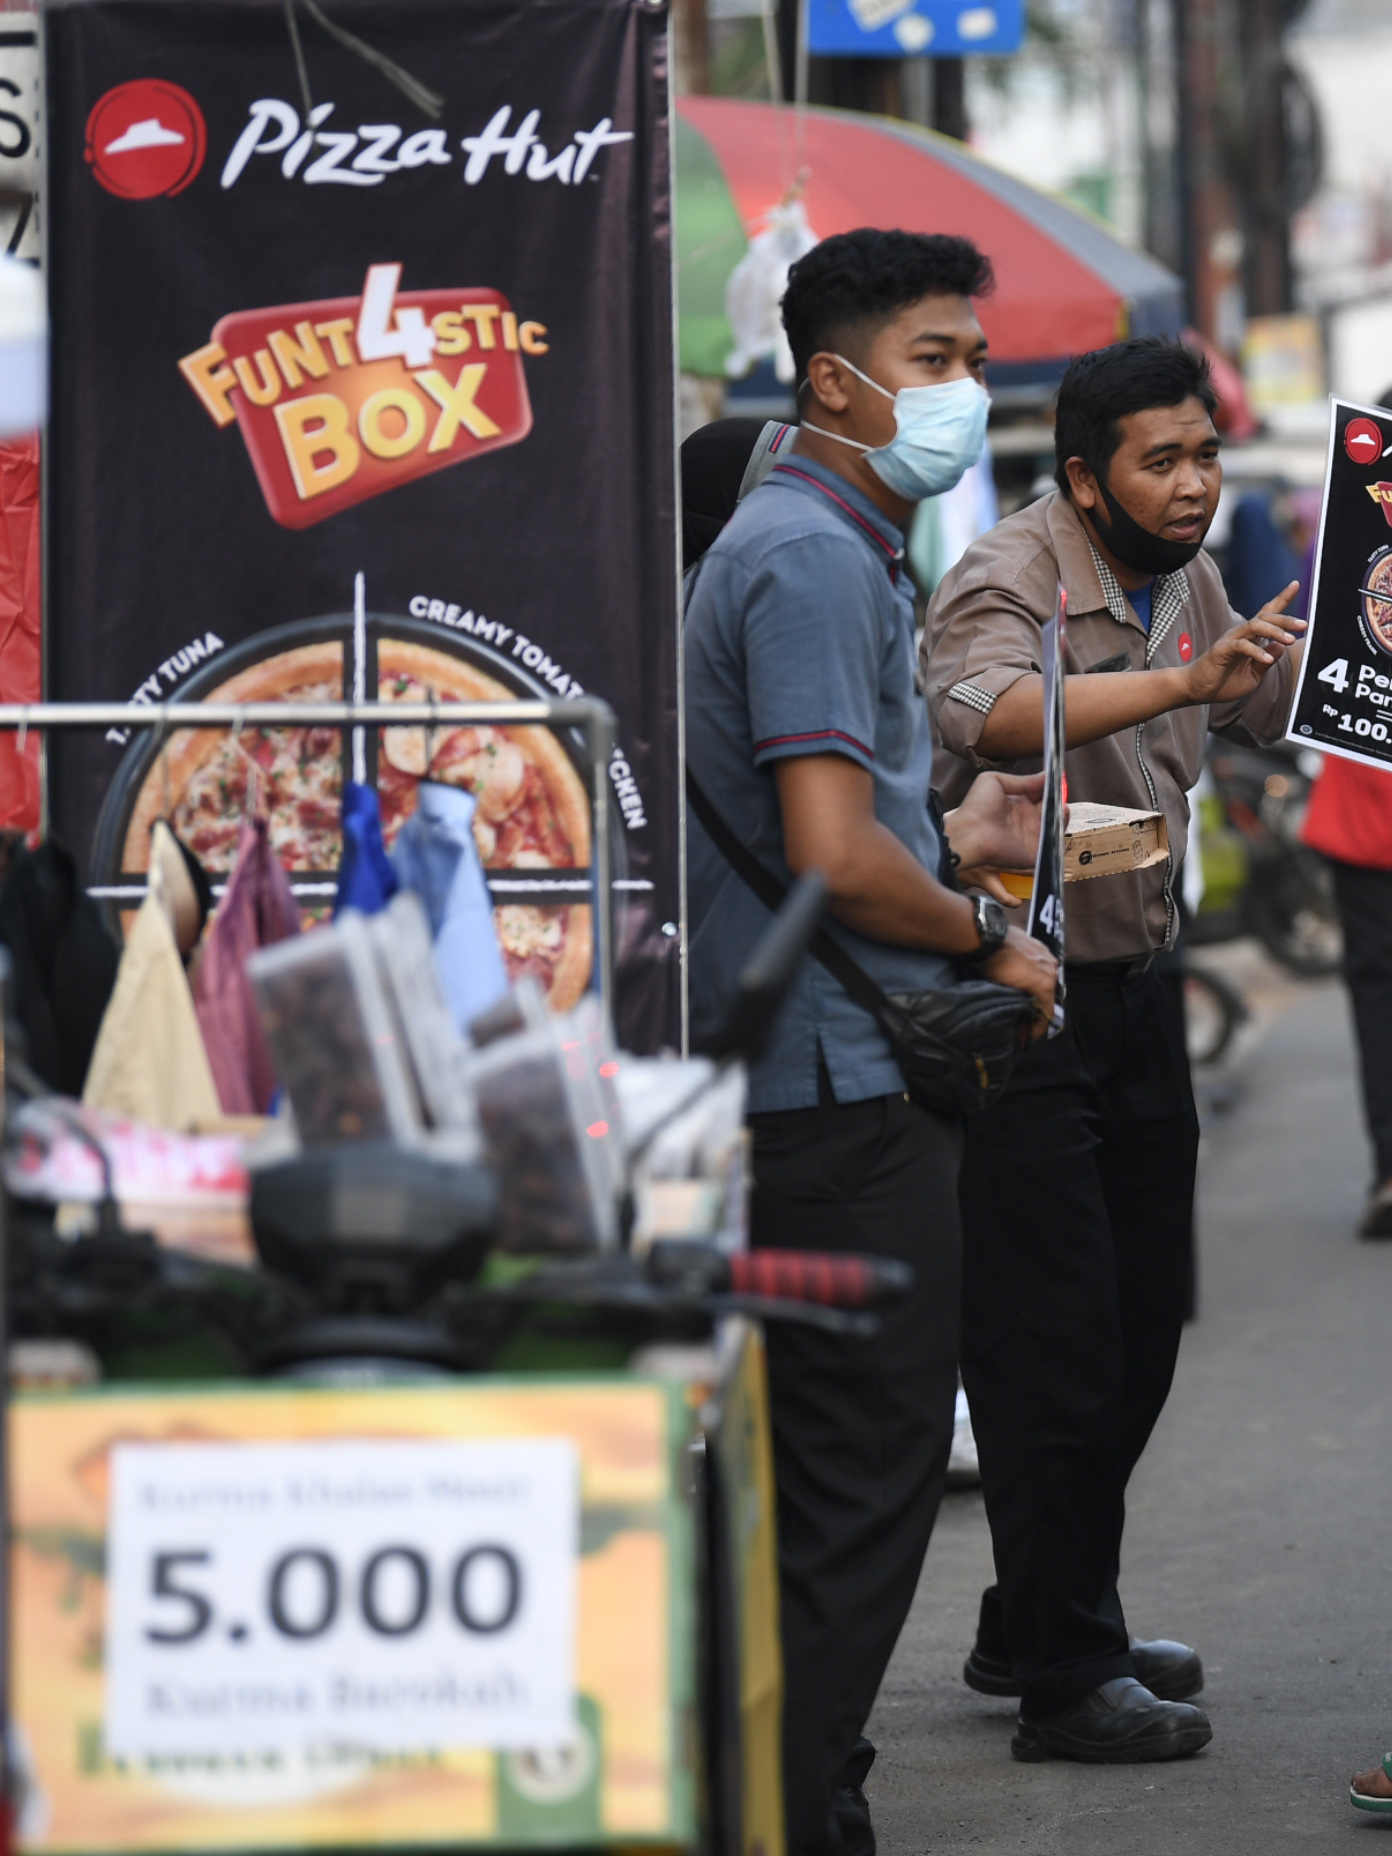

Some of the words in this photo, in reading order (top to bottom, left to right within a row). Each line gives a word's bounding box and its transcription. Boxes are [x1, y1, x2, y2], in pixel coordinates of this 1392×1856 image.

[220, 99, 452, 189] Pizza
[460, 105, 634, 185] Hut
[273, 363, 501, 500] BOX
[157, 630, 225, 682] TUNA
[408, 595, 514, 646] CREAMY
[511, 634, 585, 700] TOMAT
[1317, 657, 1350, 694] 4
[1322, 703, 1339, 717] Rp
[144, 1542, 525, 1646] 5.000
